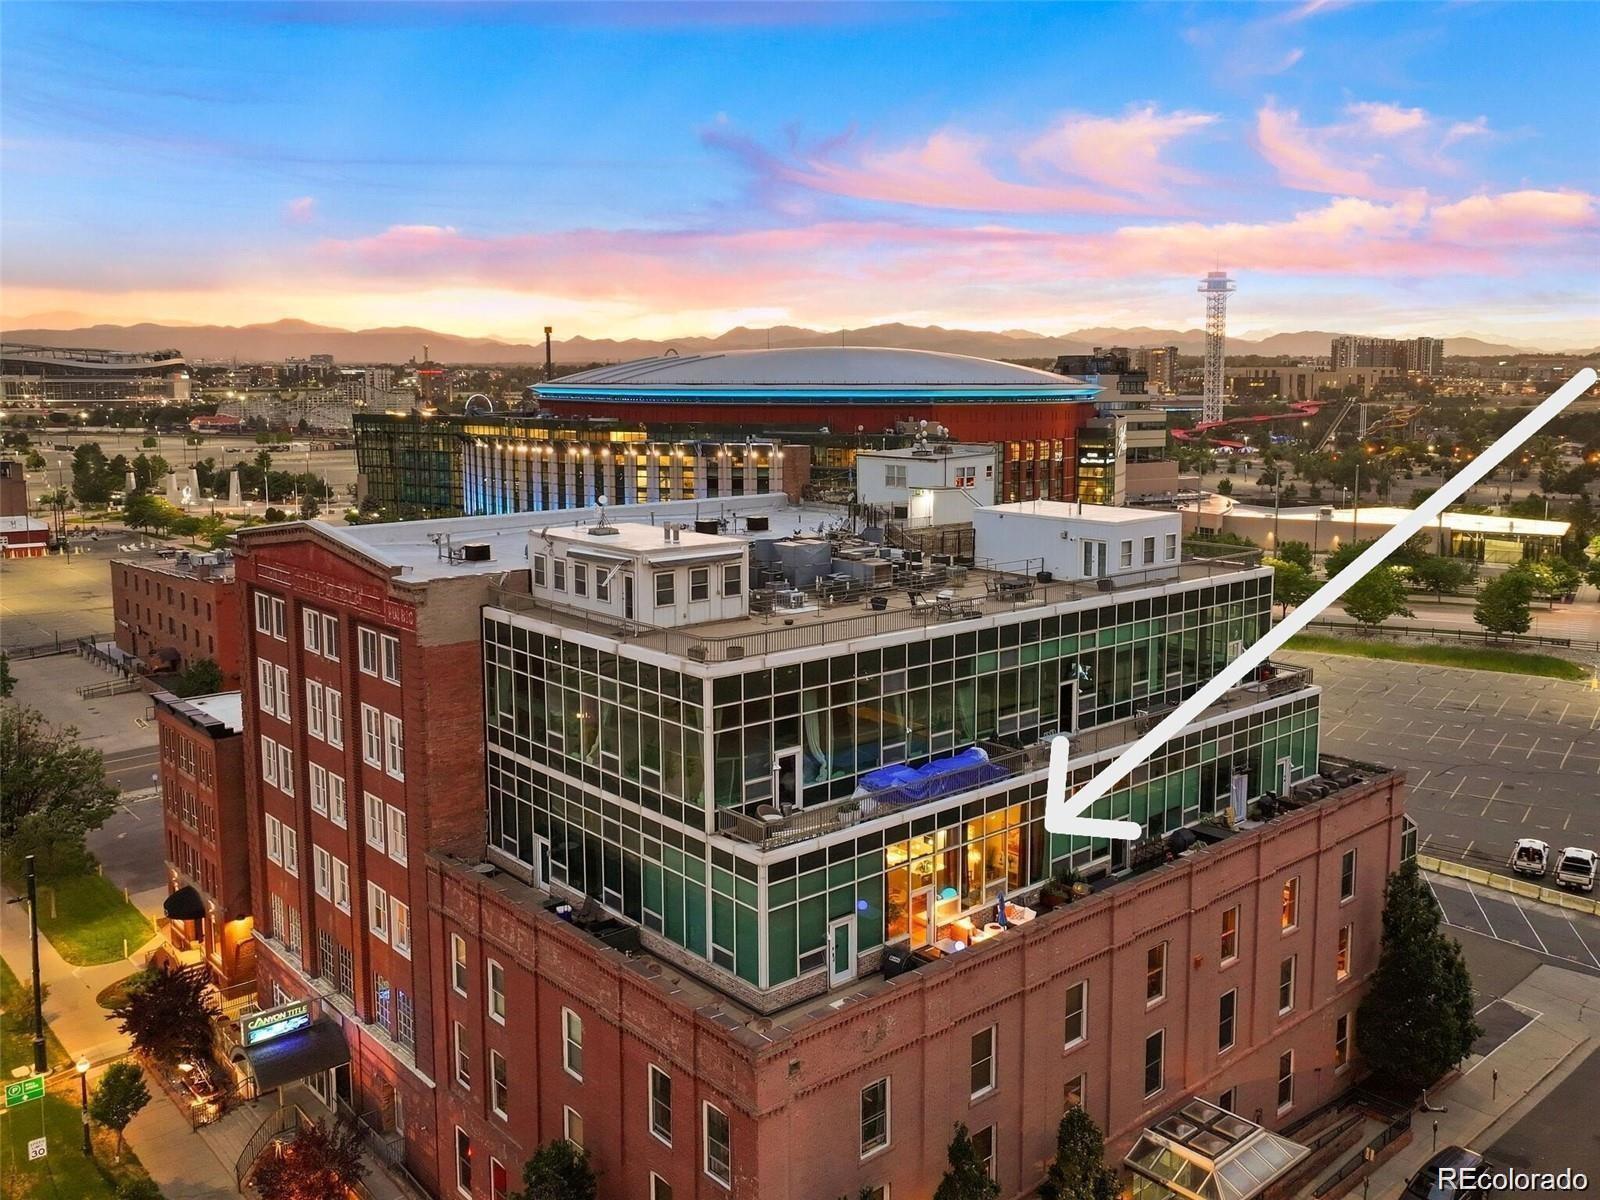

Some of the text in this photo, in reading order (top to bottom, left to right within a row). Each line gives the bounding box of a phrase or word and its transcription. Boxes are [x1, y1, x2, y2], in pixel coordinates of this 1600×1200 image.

[248, 1012, 286, 1029] CANYON
[287, 1005, 308, 1016] TITLE
[31, 1147, 46, 1158] 30
